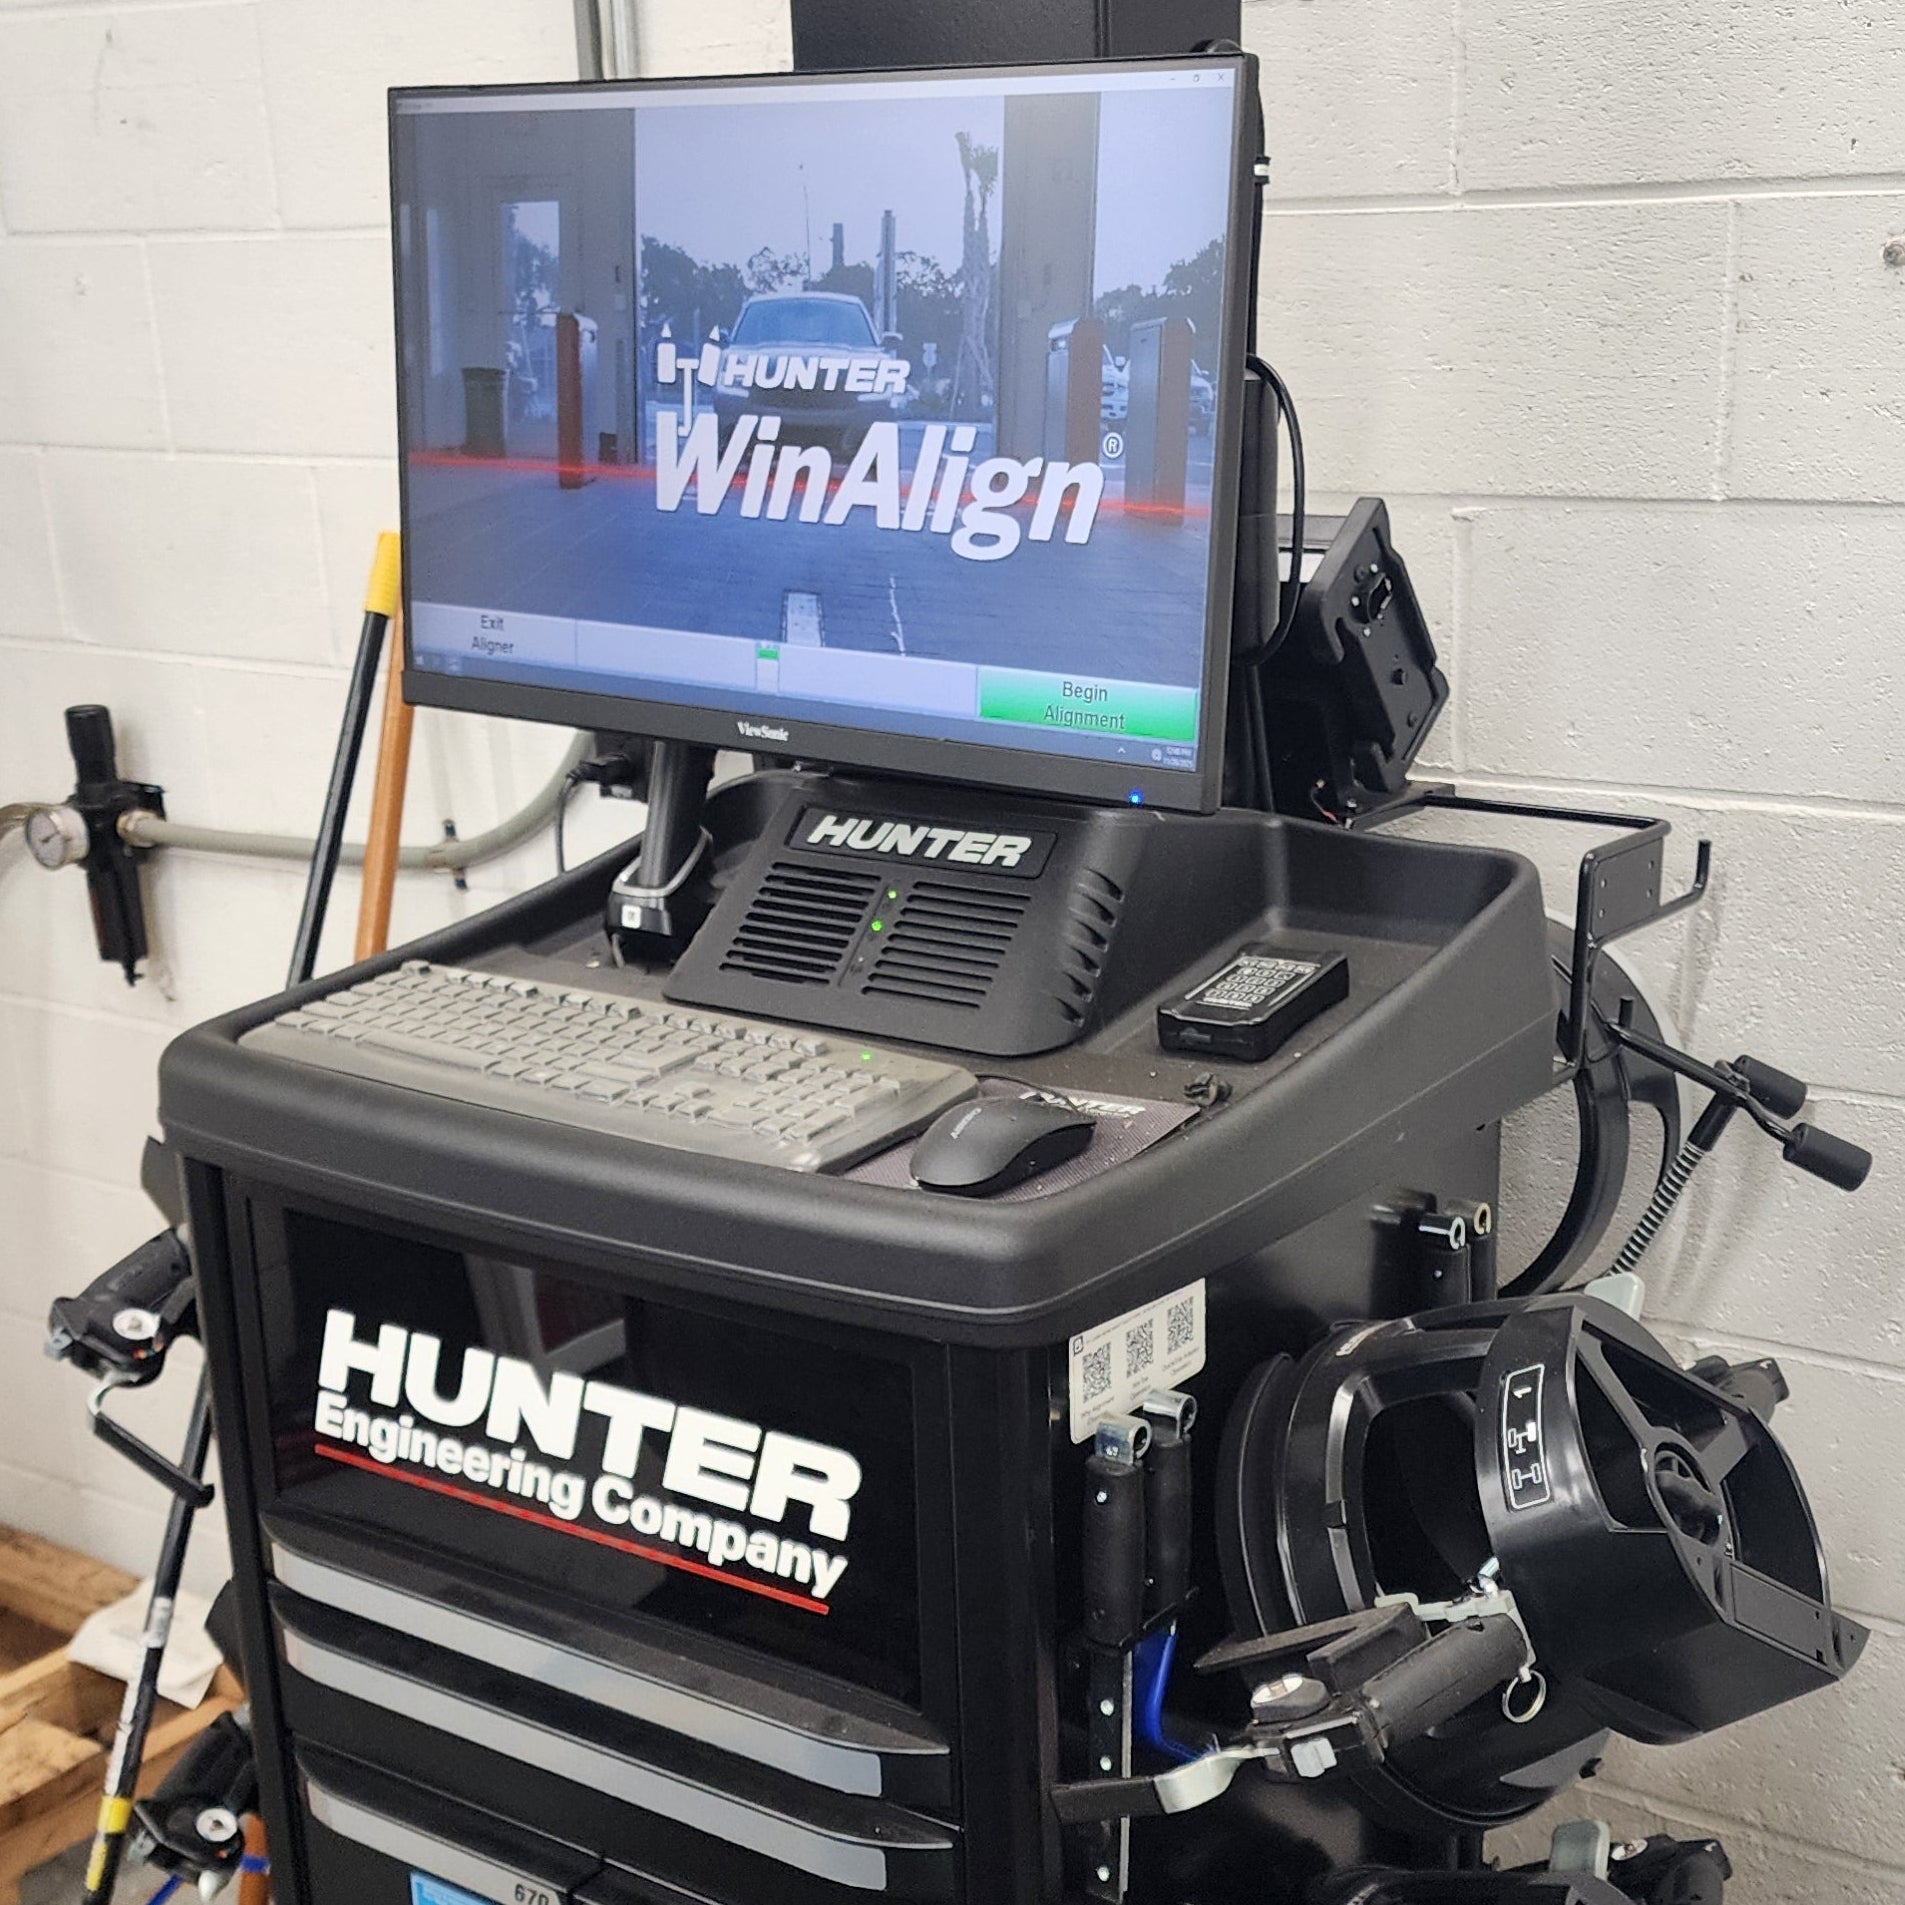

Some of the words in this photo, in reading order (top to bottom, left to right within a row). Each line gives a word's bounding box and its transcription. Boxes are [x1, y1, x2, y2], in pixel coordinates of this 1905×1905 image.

[724, 354, 910, 393] HUNTER
[655, 410, 1105, 561] WinAlign
[480, 614, 504, 631] Exit
[471, 636, 514, 655] Aligner
[1062, 681, 1108, 703] Begin
[1044, 704, 1126, 729] Alignment
[807, 815, 1032, 867] HUNTER
[319, 1309, 862, 1541] HUNTER
[315, 1390, 586, 1520] Engineering
[592, 1473, 848, 1599] Company
